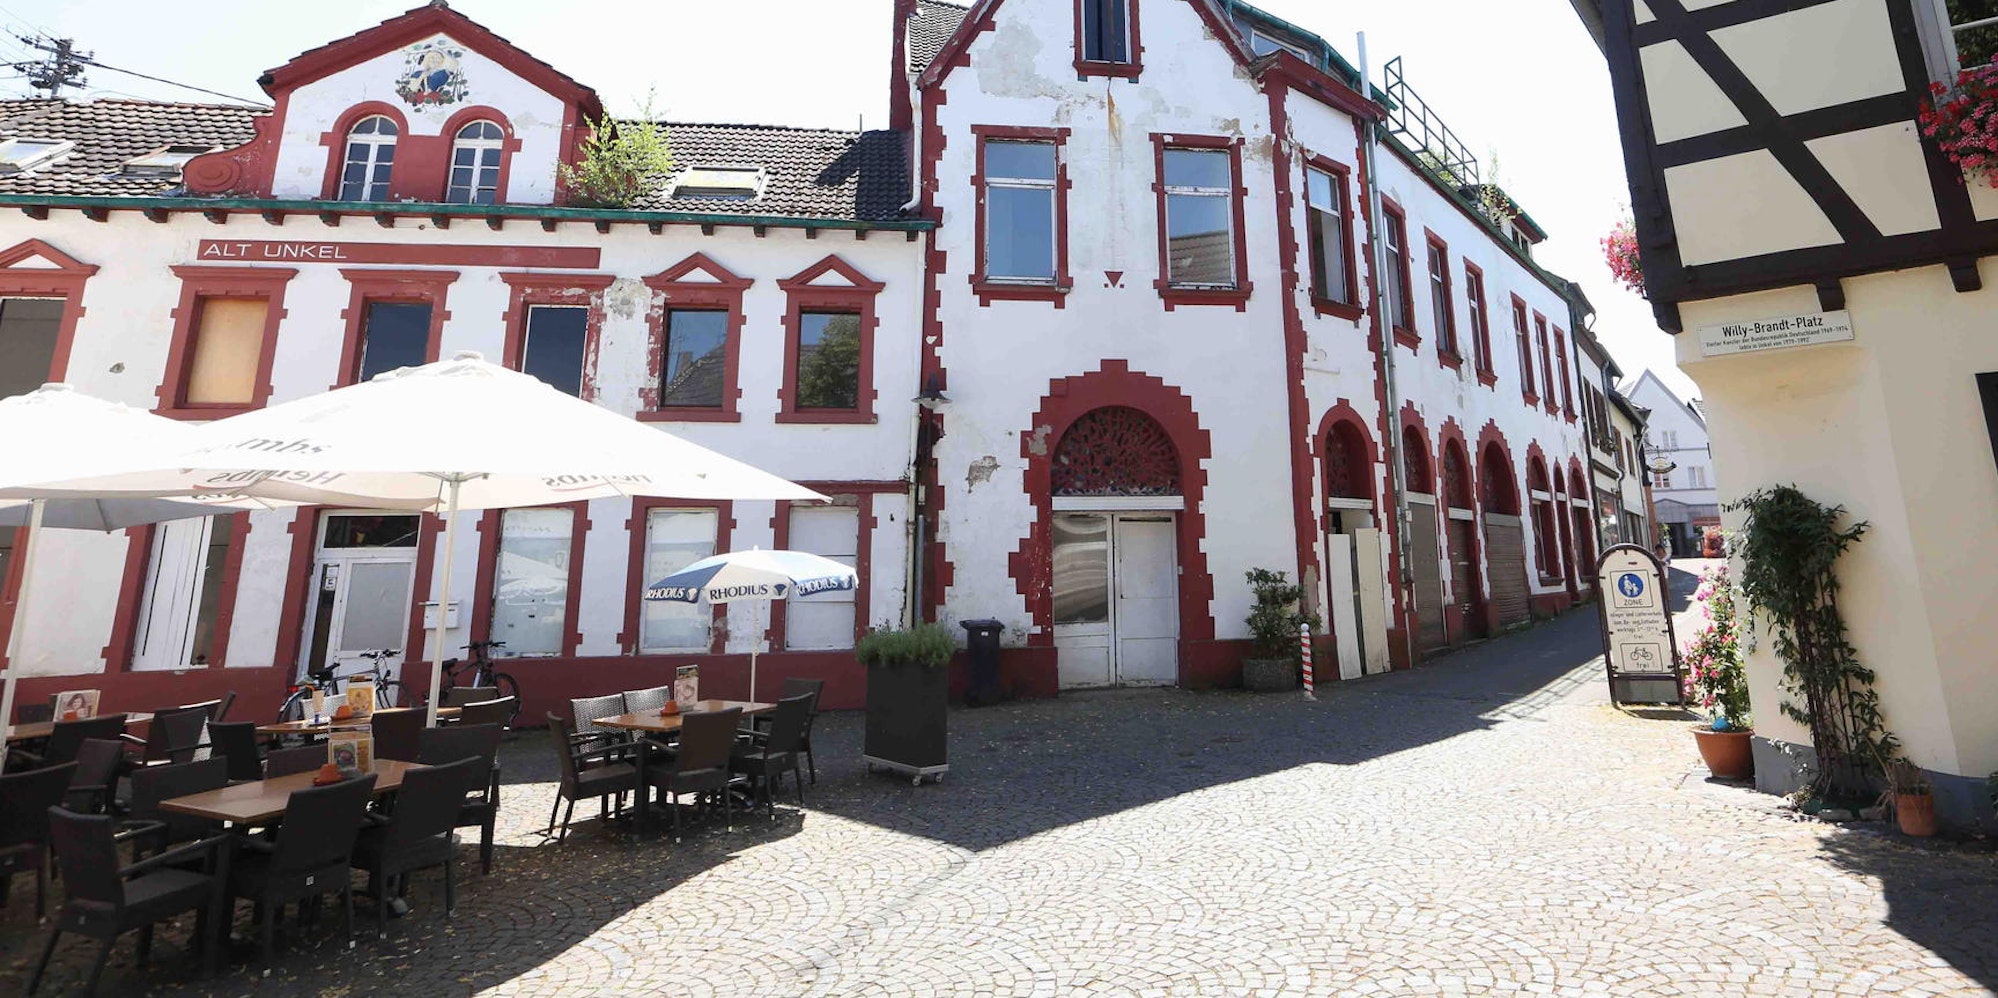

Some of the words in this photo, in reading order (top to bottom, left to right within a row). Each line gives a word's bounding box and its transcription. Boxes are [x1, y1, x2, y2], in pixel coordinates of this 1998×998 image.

[203, 243, 252, 257] ALT
[264, 244, 348, 259] UNKEL
[1722, 316, 1823, 338] Willy-Brandt-Platz
[1751, 333, 1788, 342] Bundesrepublik
[1789, 328, 1820, 337] Deutschland
[644, 587, 685, 599] RHODIUS
[709, 584, 768, 600] RHODIUS
[795, 577, 838, 596] RHODIUS
